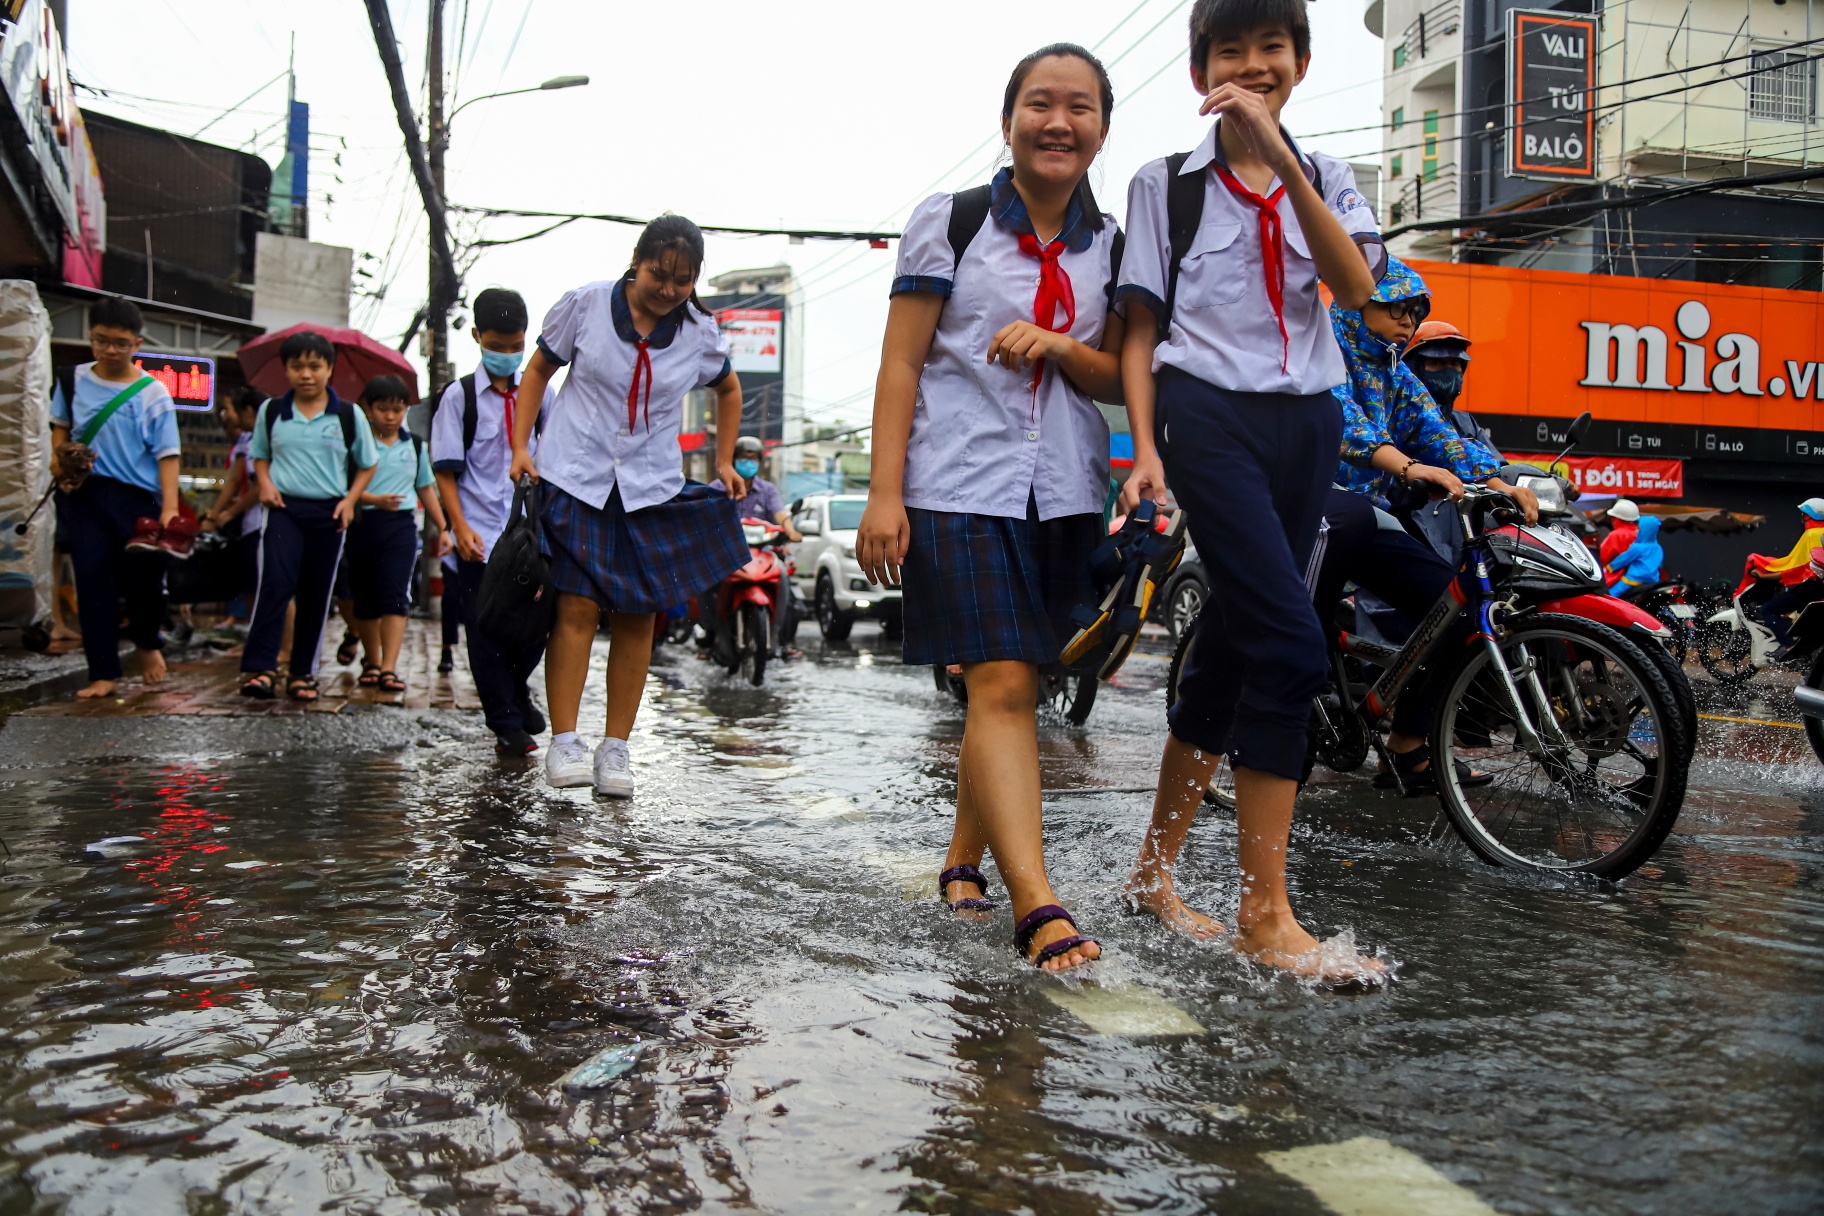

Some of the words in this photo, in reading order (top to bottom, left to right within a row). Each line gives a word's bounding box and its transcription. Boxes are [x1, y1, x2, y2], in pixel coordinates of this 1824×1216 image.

[1541, 33, 1584, 59] VALI
[1548, 84, 1583, 111] TÚI
[1524, 132, 1583, 160] BALÔ
[1579, 300, 1824, 399] mia.v
[1646, 436, 1661, 447] TÚI
[1719, 441, 1730, 451] BA
[1732, 441, 1744, 451] LÔ
[1573, 468, 1582, 486] 1
[1585, 463, 1622, 487] ĐỔI
[1626, 470, 1634, 488] 1
[1637, 471, 1660, 480] TRONG
[1654, 478, 1680, 490] NGÀY
